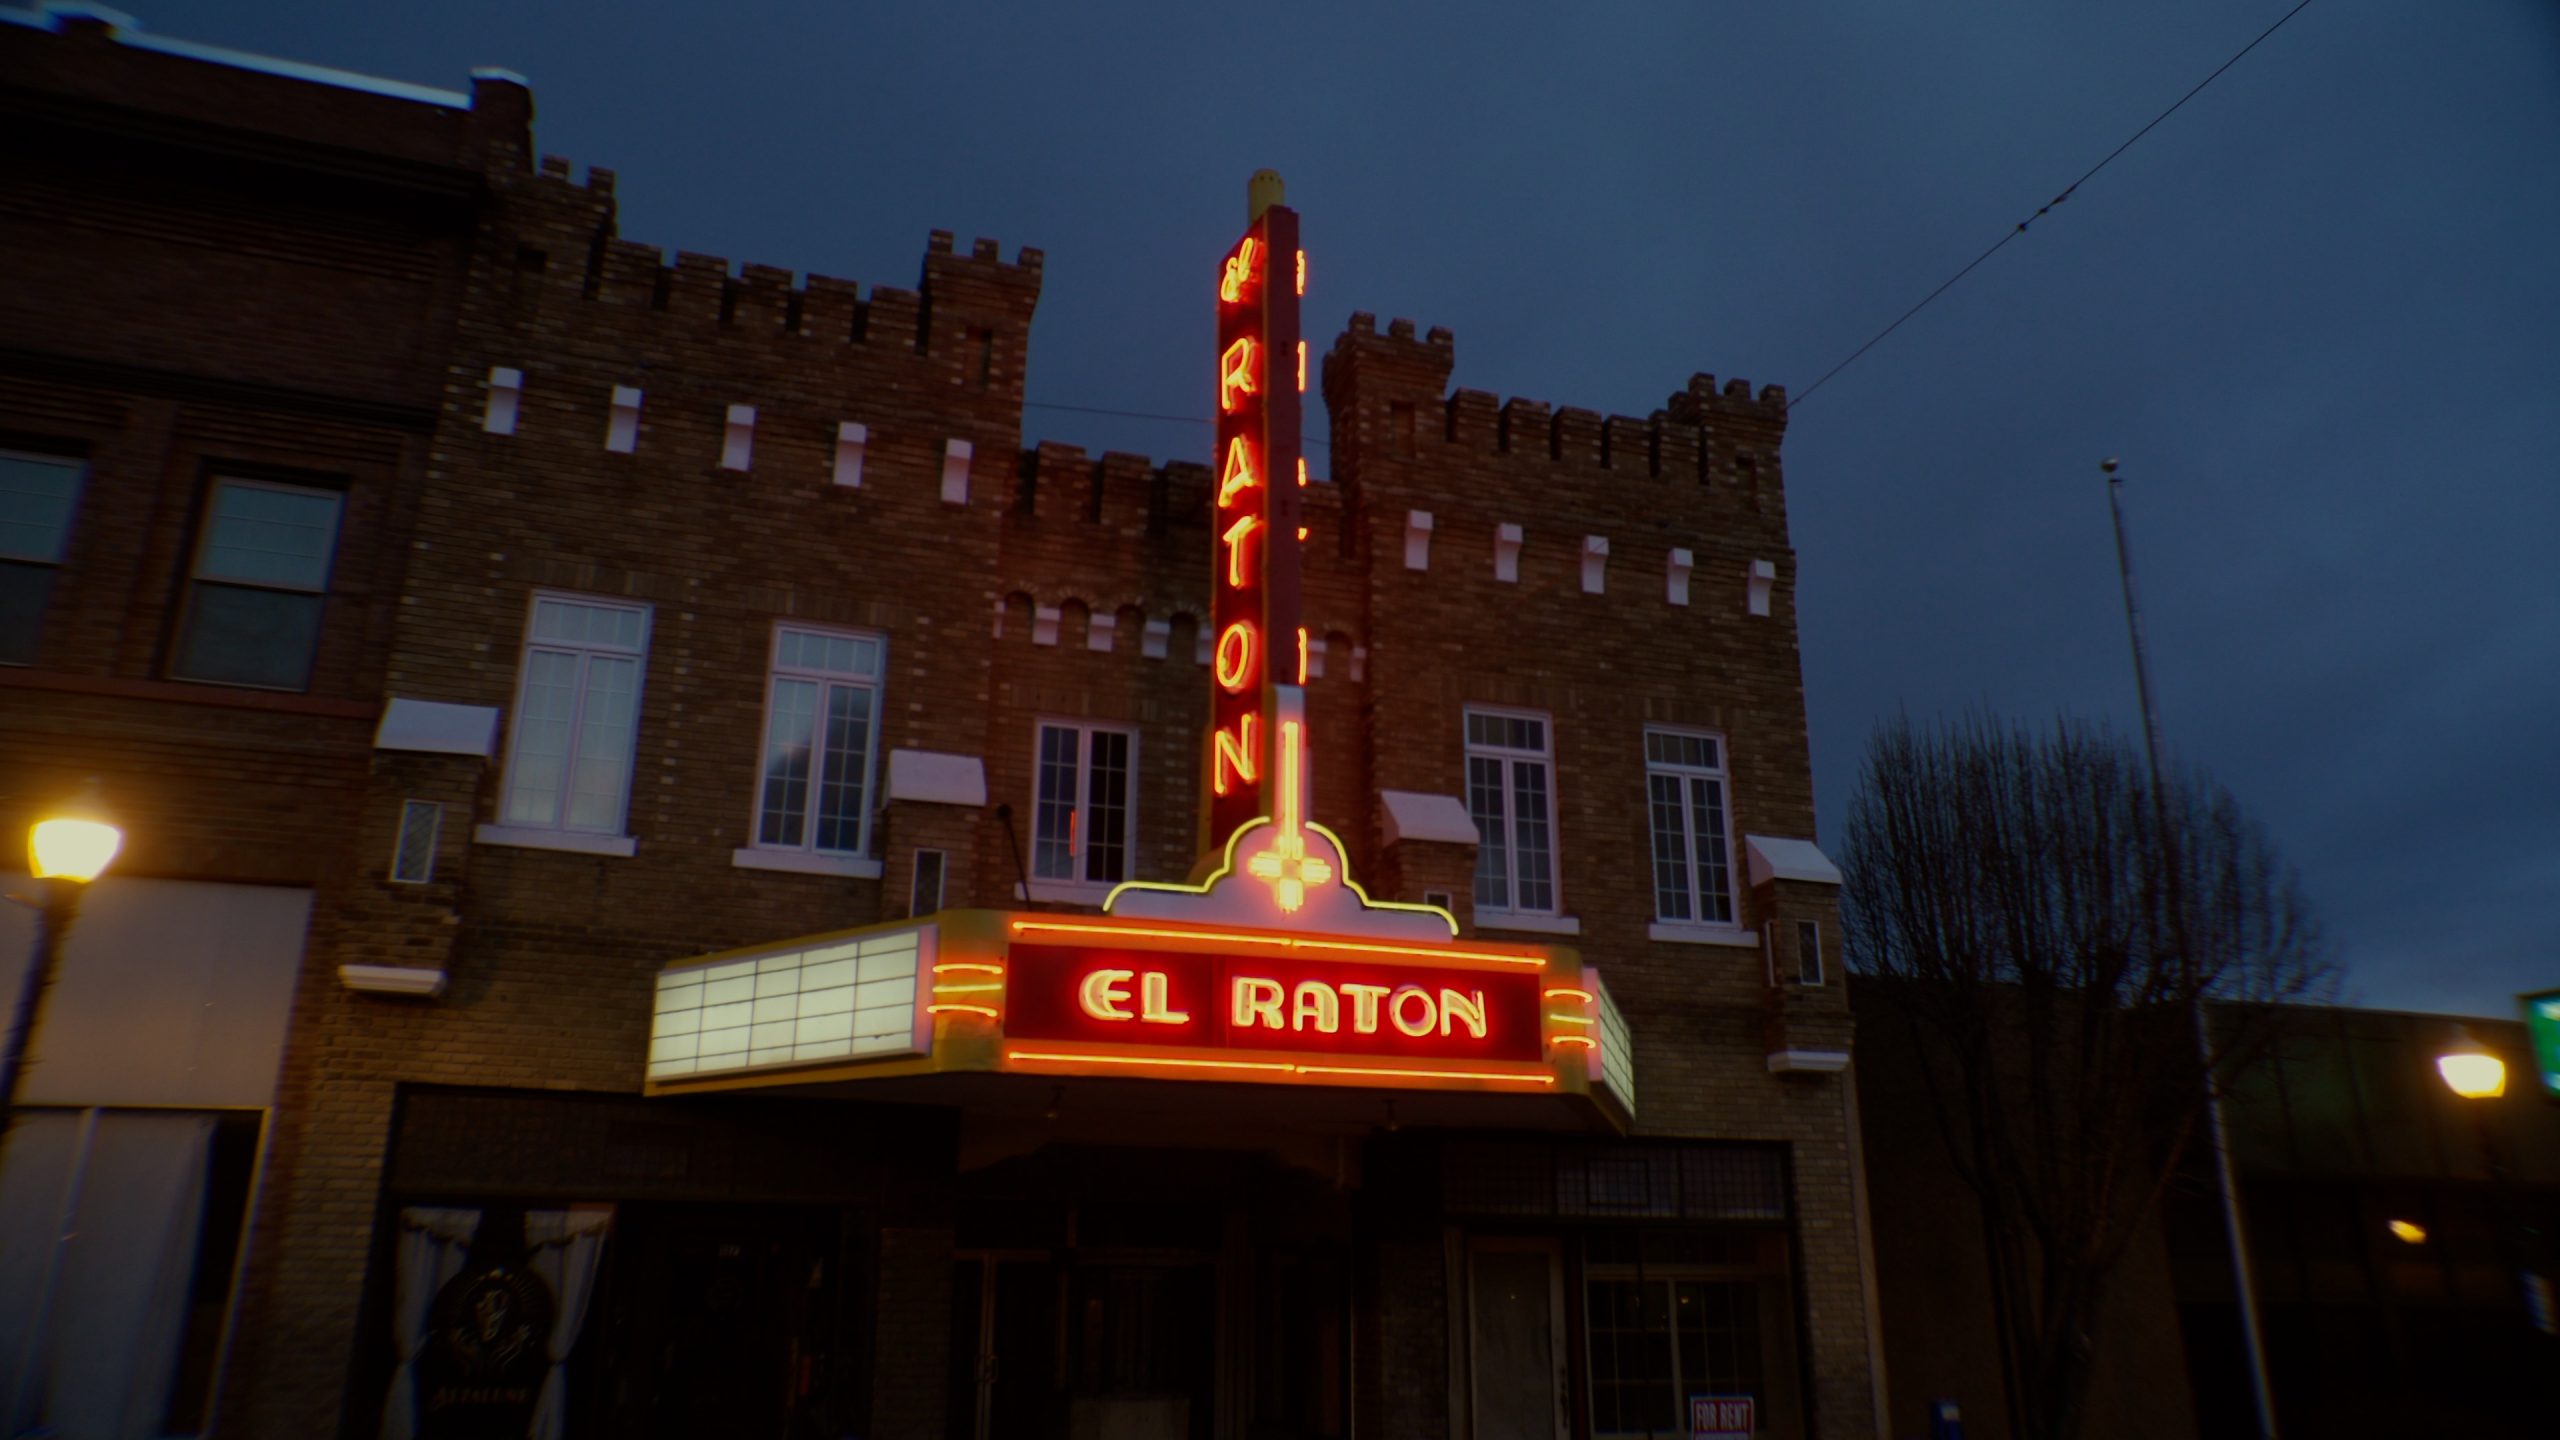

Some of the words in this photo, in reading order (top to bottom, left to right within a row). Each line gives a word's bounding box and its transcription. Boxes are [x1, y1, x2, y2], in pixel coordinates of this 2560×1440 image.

[1215, 336, 1257, 795] RATON
[1078, 968, 1190, 1025] EL
[1231, 976, 1488, 1039] RATON
[1695, 1402, 1717, 1431] FOR
[1720, 1402, 1750, 1432] RENT
